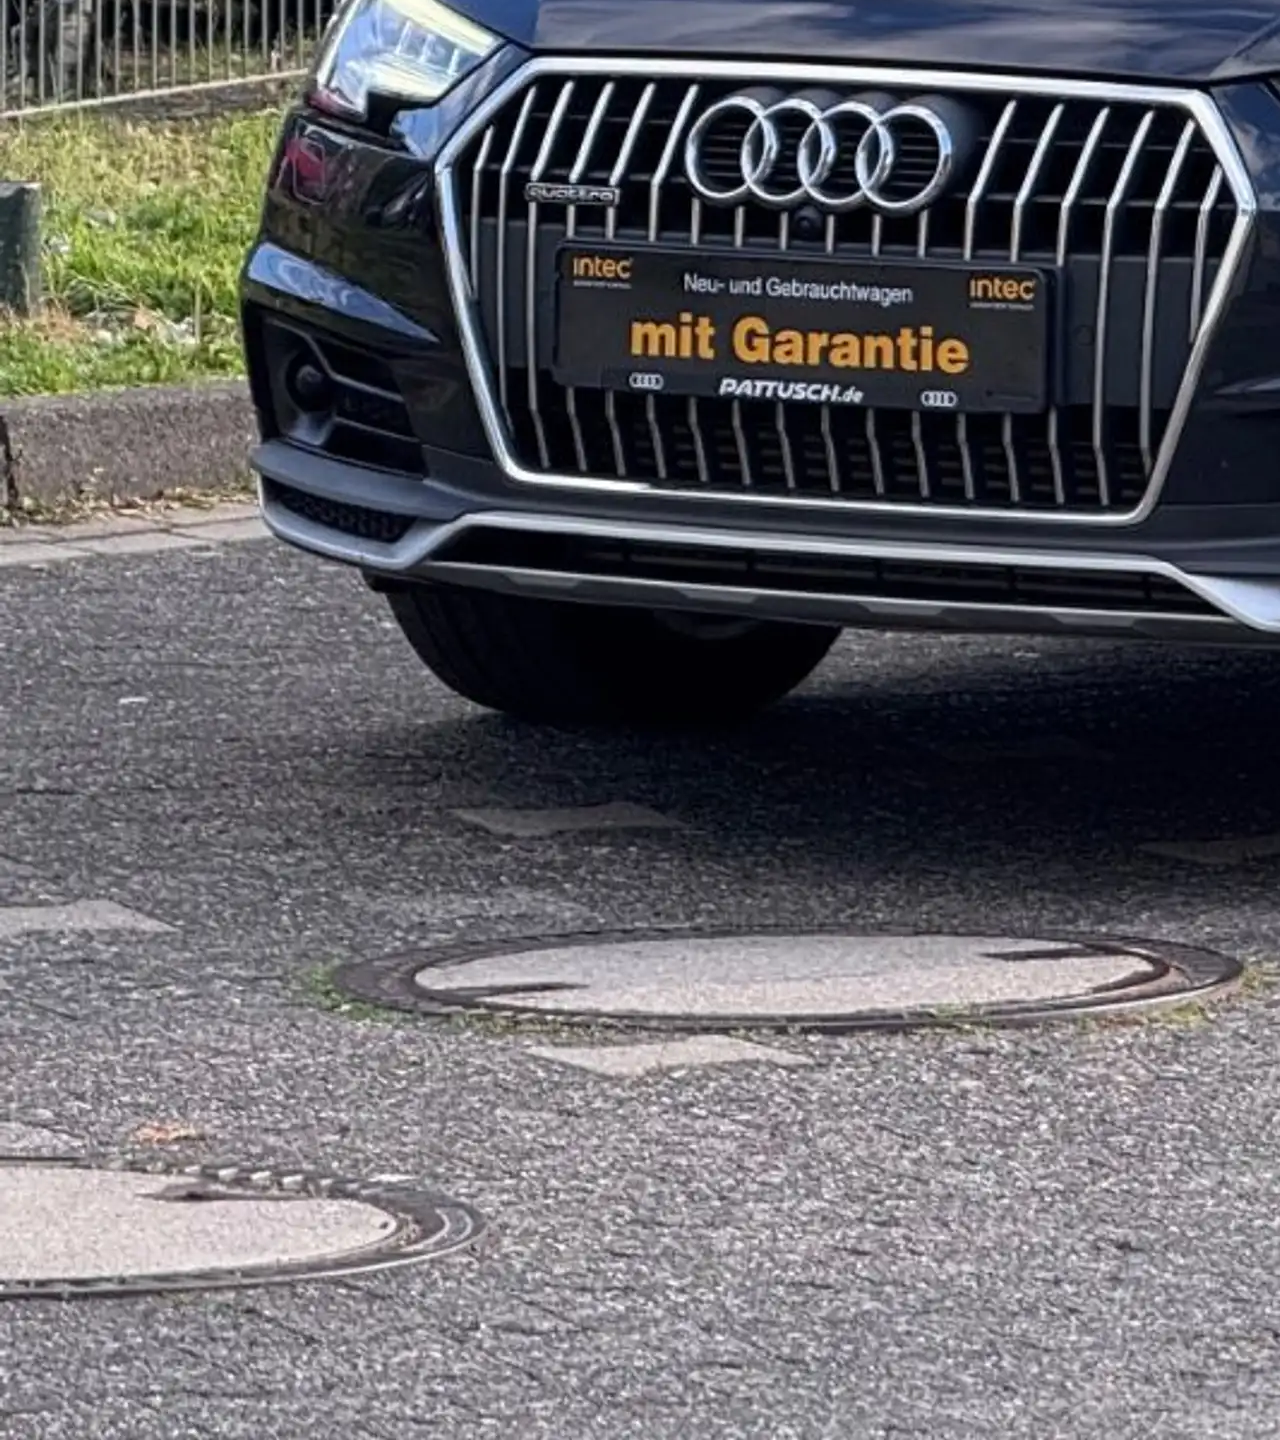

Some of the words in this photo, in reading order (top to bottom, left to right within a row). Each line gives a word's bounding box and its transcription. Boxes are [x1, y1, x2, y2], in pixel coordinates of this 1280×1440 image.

[683, 272, 724, 294] Neu-
[729, 277, 761, 295] und
[765, 276, 914, 308] Gebrauchtwagen
[630, 311, 716, 360] mit
[732, 315, 969, 375] Garantie
[719, 377, 865, 404] PATTUSCH.de
